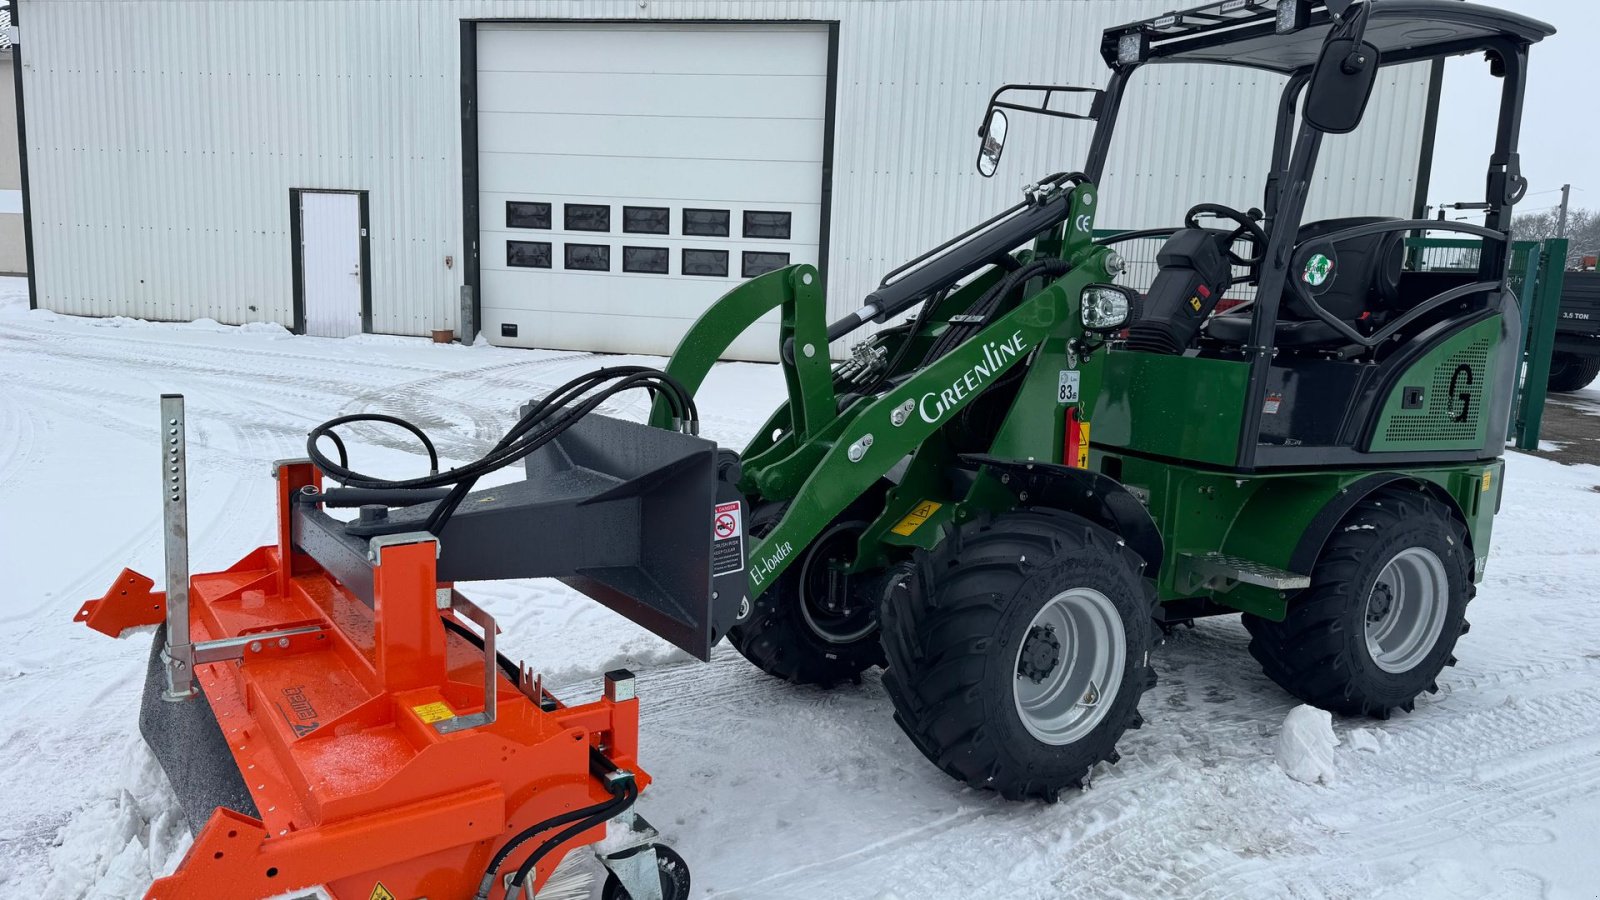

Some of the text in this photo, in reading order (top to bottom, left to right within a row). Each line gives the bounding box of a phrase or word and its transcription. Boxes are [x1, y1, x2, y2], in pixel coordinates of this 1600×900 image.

[1076, 214, 1091, 233] CE
[1060, 384, 1072, 400] 83
[1449, 363, 1473, 423] G
[718, 504, 736, 512] DANGER
